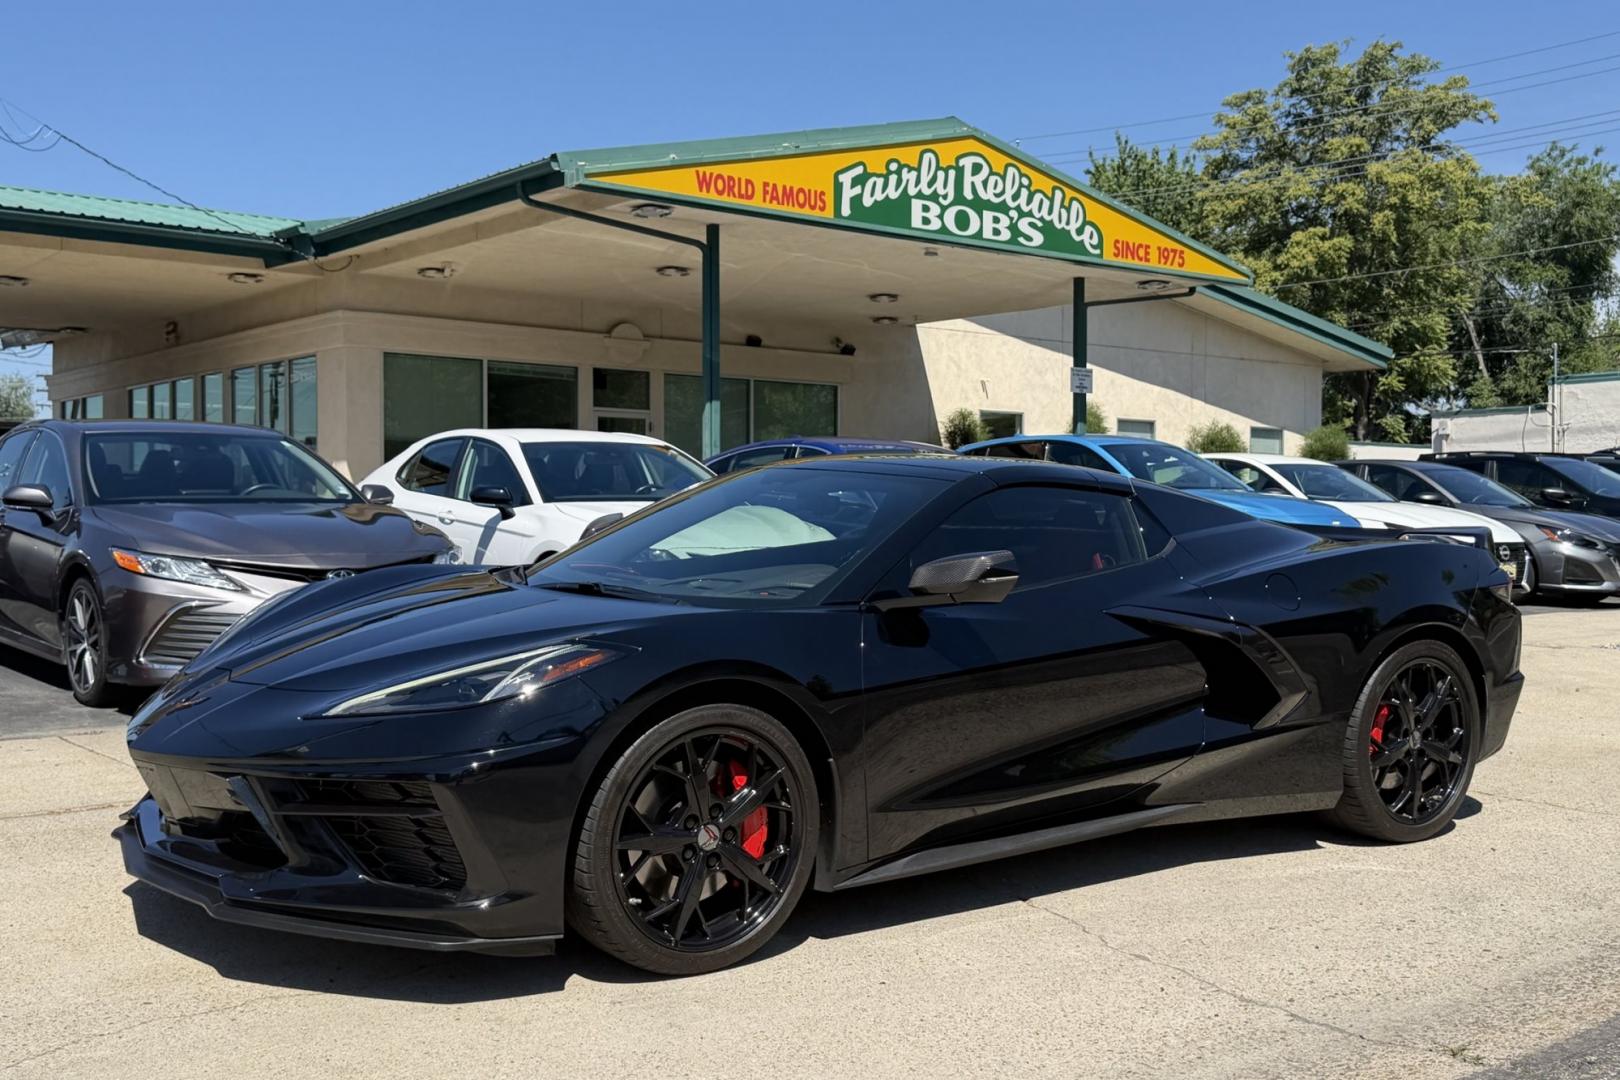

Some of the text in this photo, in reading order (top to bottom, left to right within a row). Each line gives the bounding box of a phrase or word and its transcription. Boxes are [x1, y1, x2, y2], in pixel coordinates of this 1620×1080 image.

[696, 170, 826, 212] WORLD FAMOUS
[838, 151, 1101, 254] Fairly Reliable
[911, 199, 1045, 247] BOB'S
[1113, 239, 1186, 268] SINCE 1975
